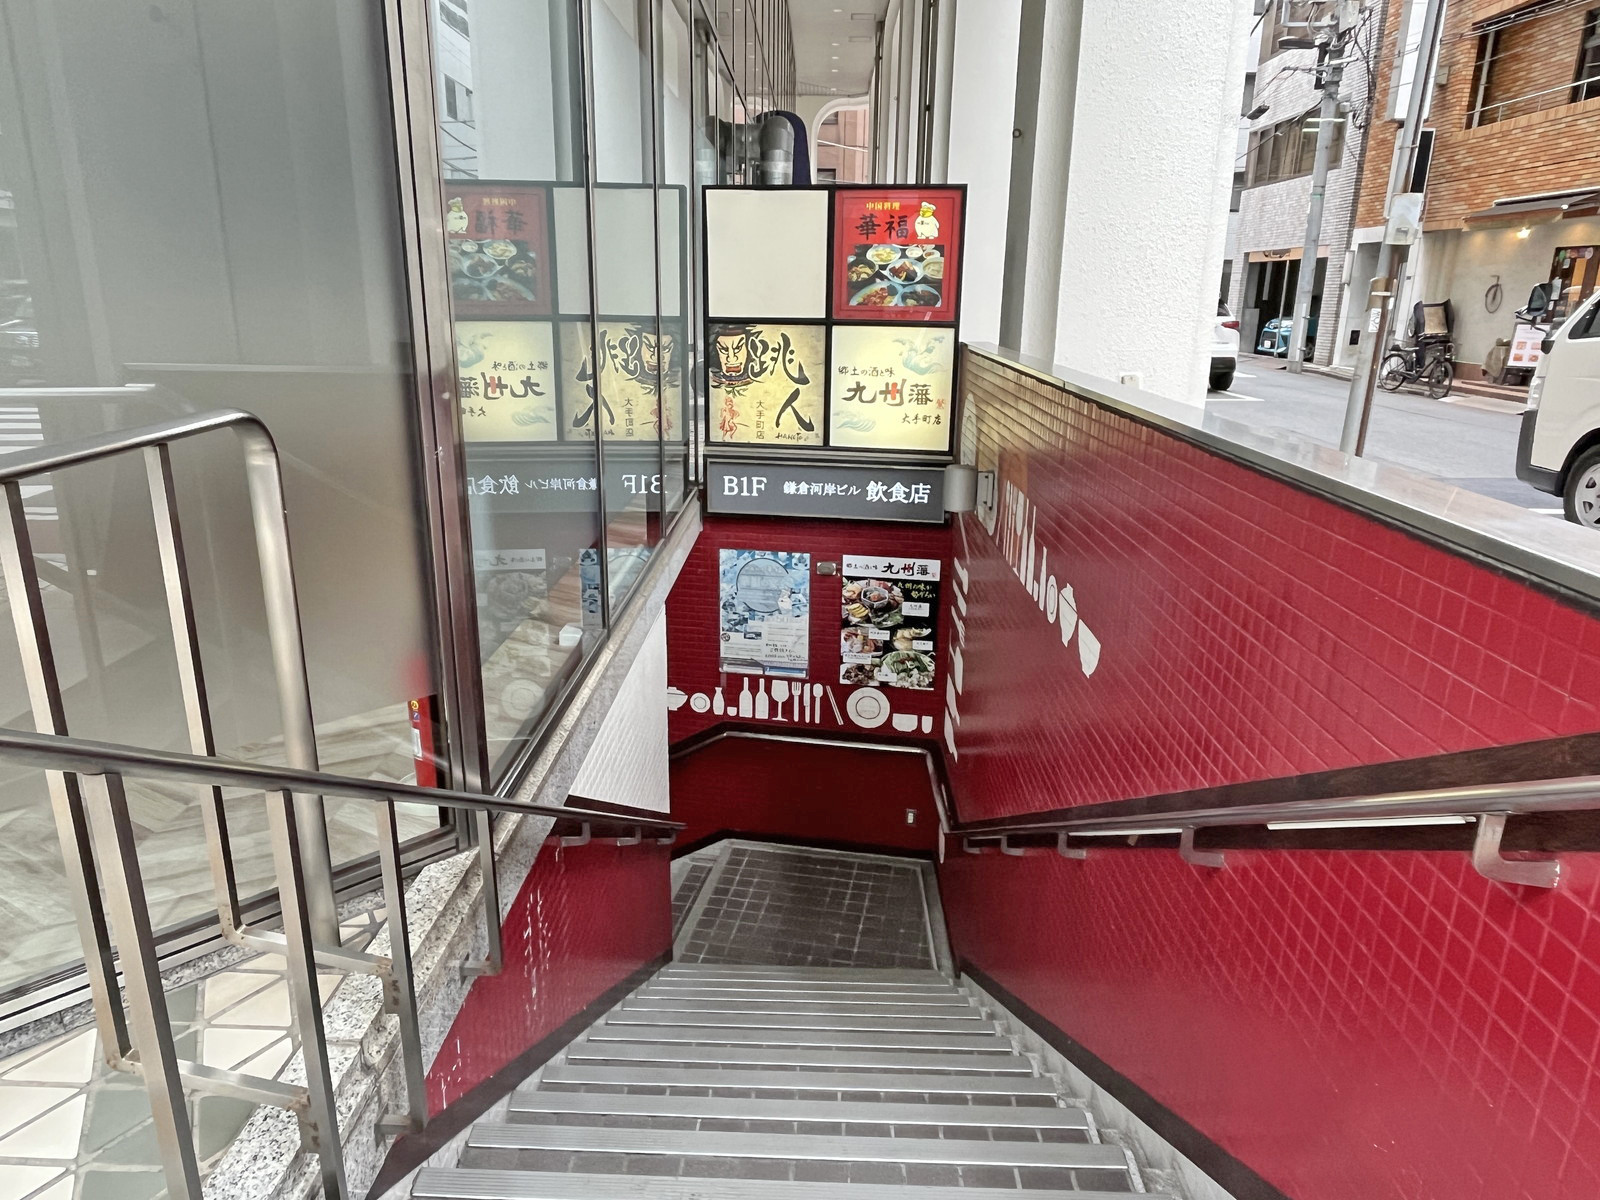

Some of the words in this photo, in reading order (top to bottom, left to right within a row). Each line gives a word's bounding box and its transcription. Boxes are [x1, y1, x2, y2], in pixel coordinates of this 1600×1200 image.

[866, 202, 900, 211] 中国料理
[855, 213, 909, 240] 華福
[838, 366, 895, 377] 郷土の酒と味
[841, 379, 933, 406] 九州藩
[756, 400, 765, 439] 大手町店
[901, 413, 941, 425] 大手町店
[723, 476, 767, 496] B1F
[783, 481, 861, 496] 鎌倉河岸ビル
[866, 481, 931, 503] 飲食店
